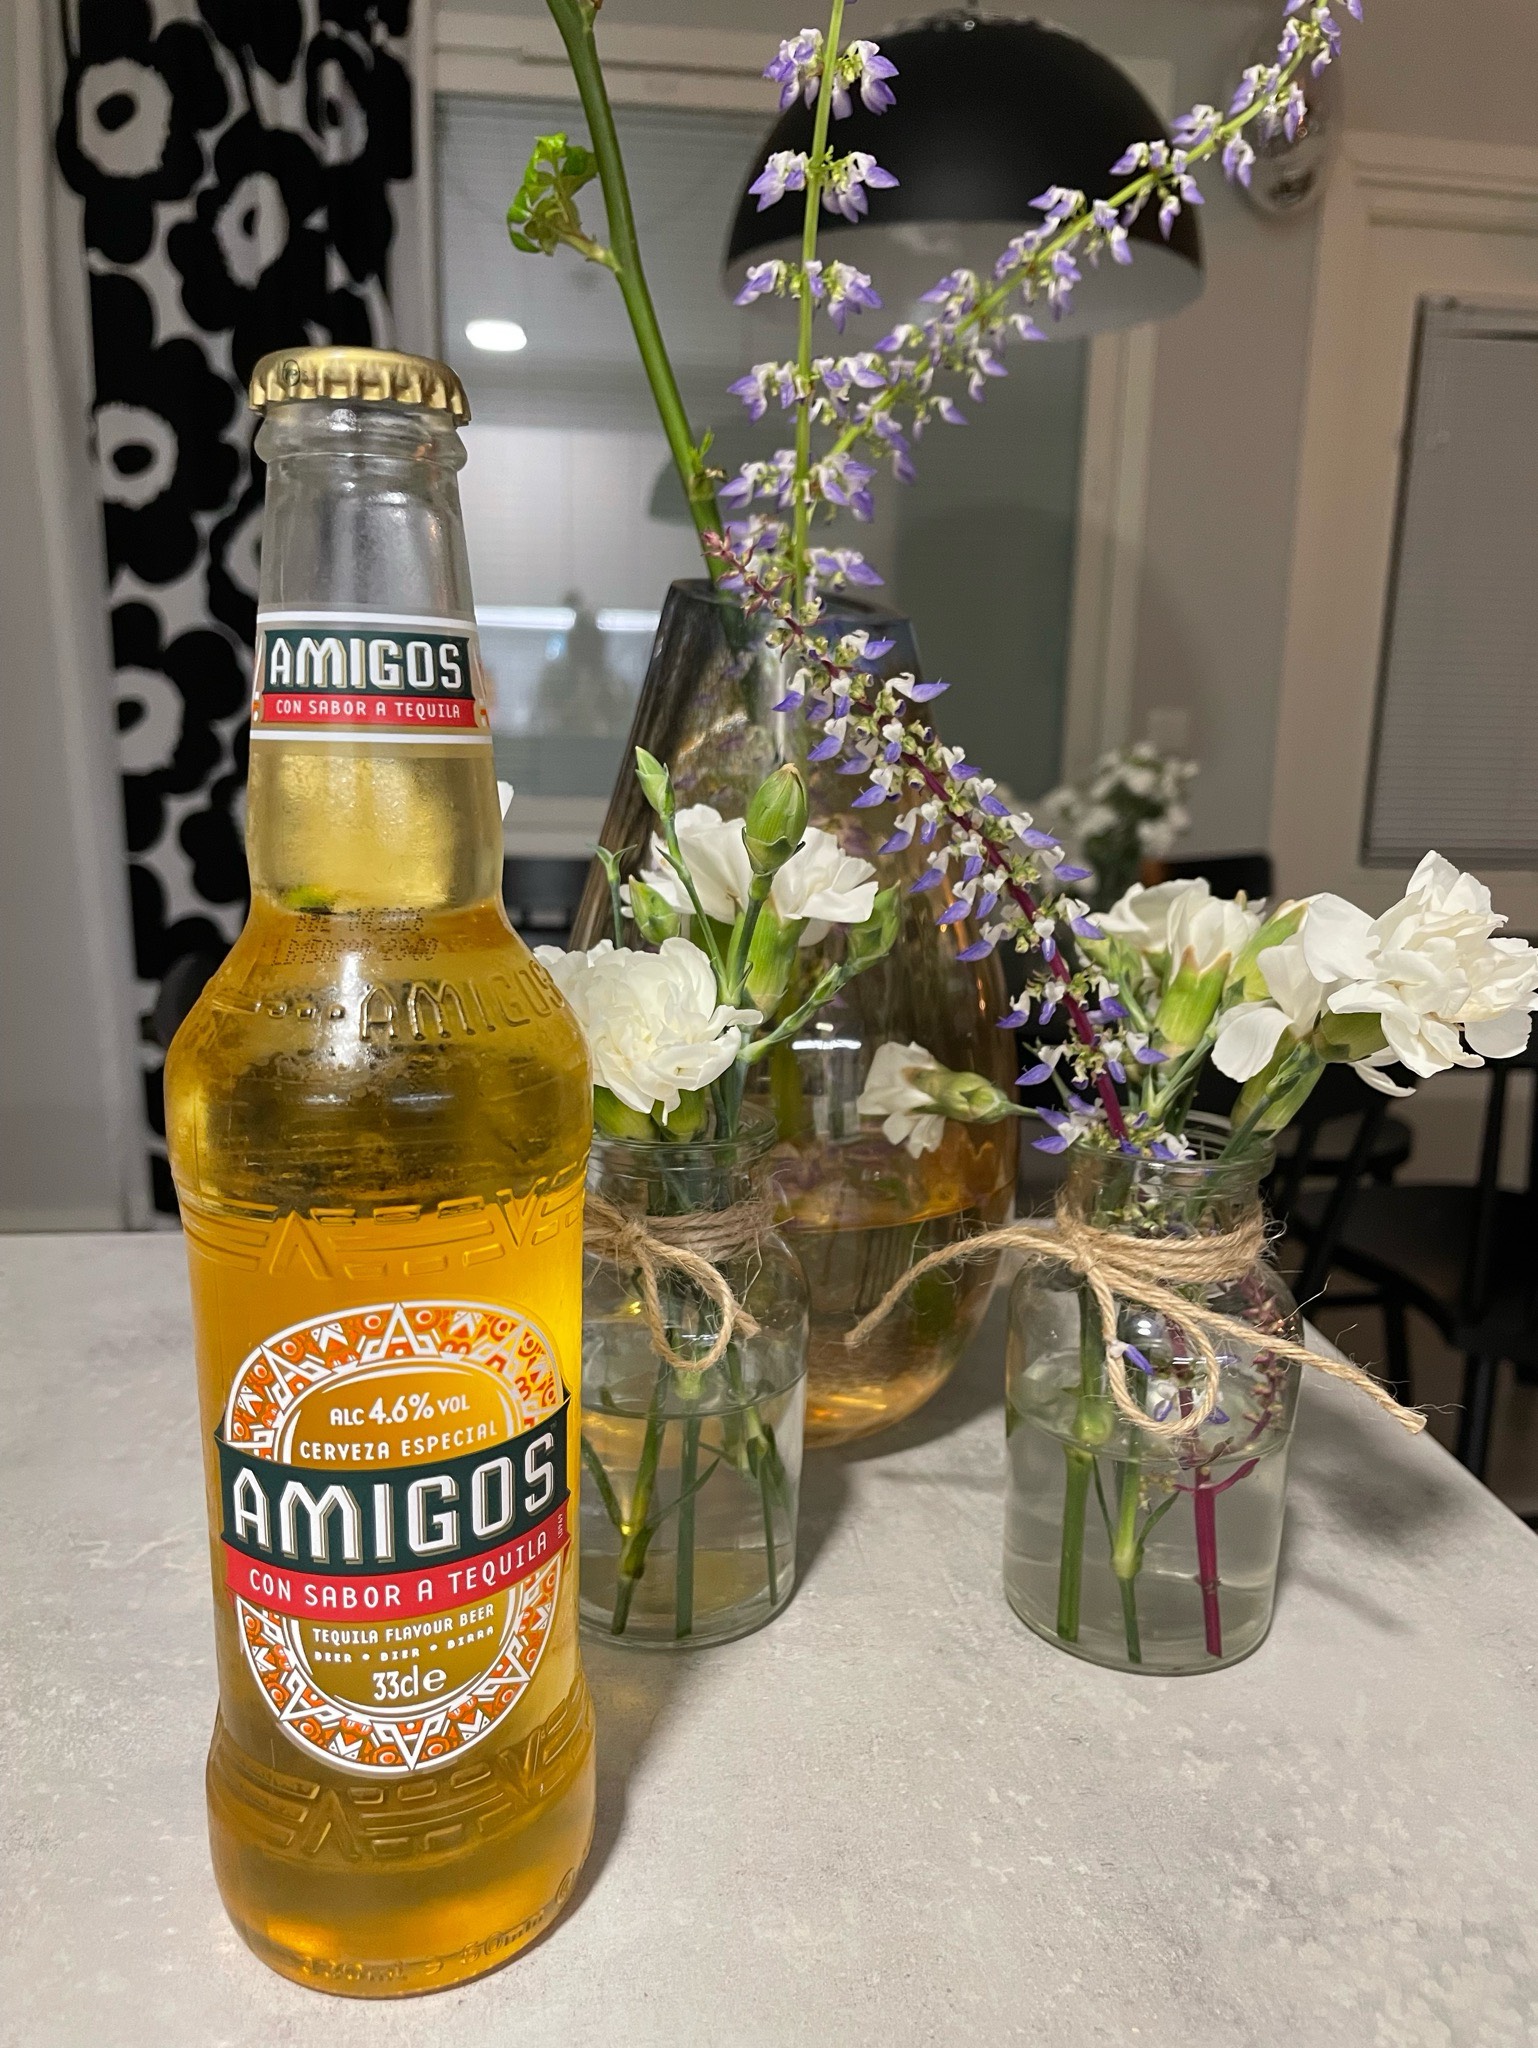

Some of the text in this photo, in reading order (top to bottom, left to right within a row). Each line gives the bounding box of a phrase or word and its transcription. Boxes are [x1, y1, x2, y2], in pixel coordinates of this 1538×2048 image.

[271, 637, 463, 690] AMIGOS
[276, 699, 460, 719] CON SABOR A TEQUILA
[359, 959, 564, 1041] AMIGOS
[330, 1392, 470, 1426] ALC 4.6% VOL
[300, 1420, 497, 1461] CERVEZA ESPECIAL
[233, 1432, 556, 1564] AMIGOS
[250, 1531, 548, 1609] CON SABOR A TEQUILA
[313, 1604, 494, 1646] TEQUILA FLAVOUR BEER
[381, 1648, 419, 1662] BIER
[447, 1626, 494, 1649] BIRRA
